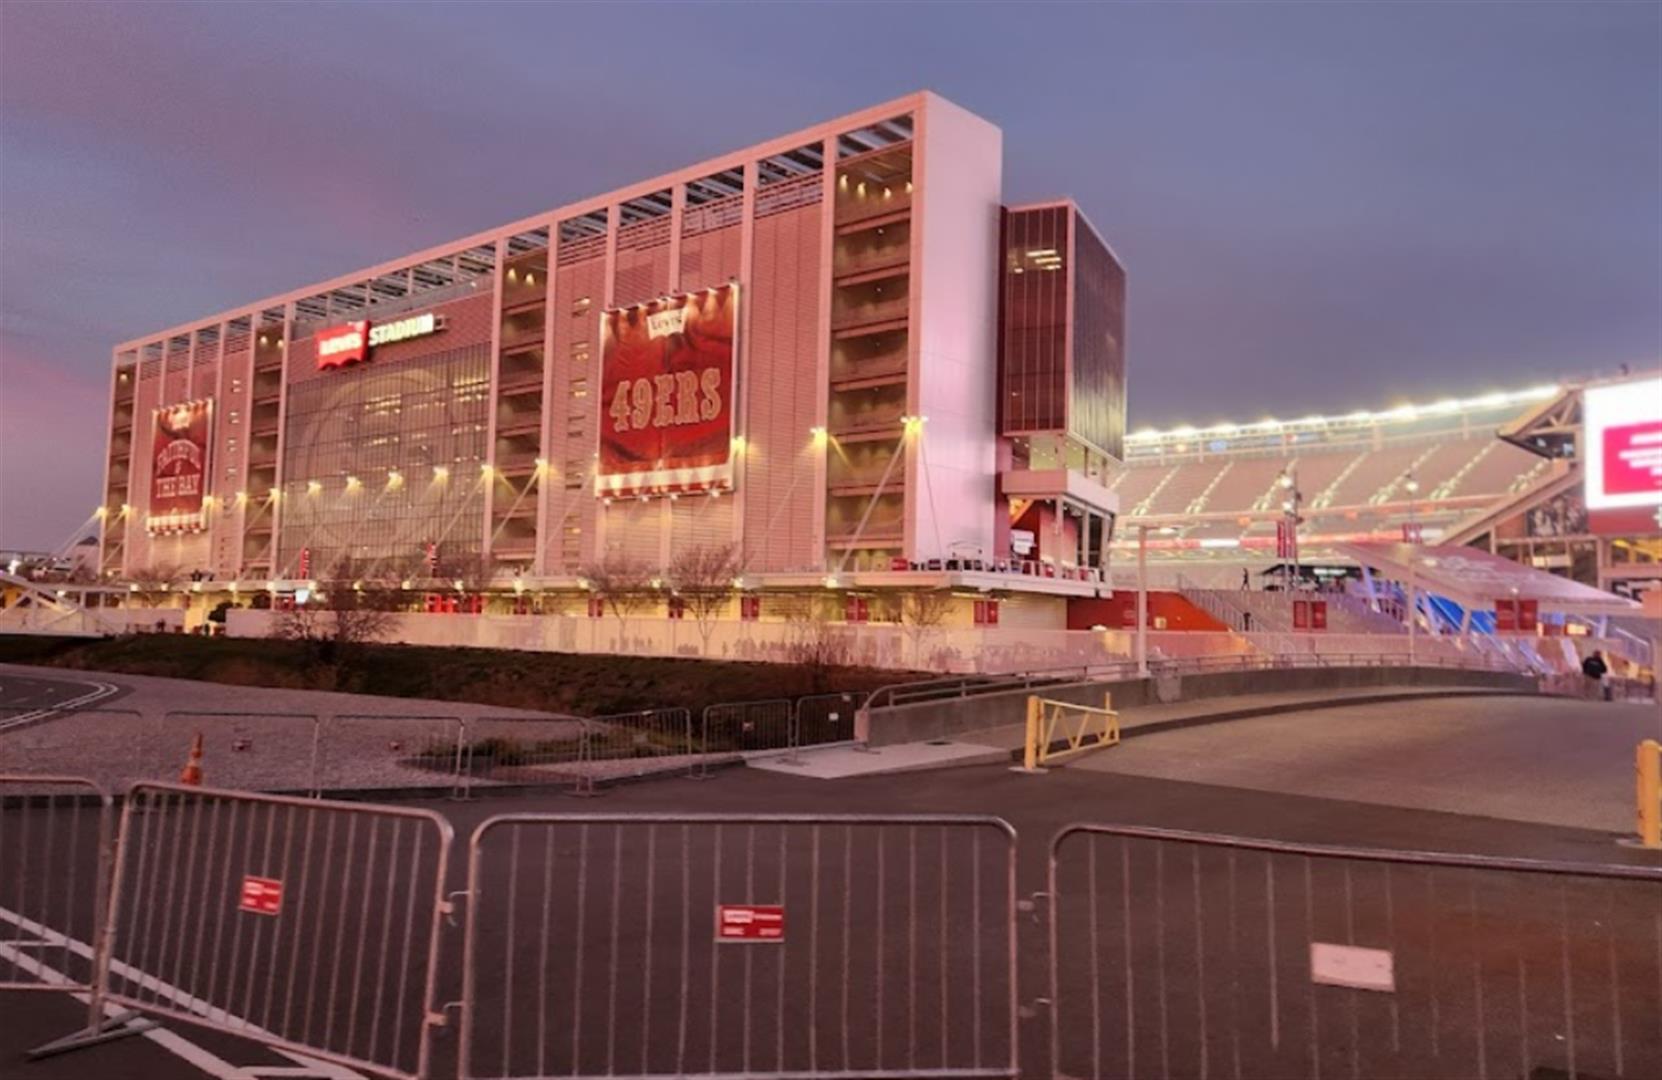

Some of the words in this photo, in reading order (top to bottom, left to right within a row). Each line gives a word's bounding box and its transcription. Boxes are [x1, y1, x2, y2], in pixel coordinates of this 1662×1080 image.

[368, 313, 434, 347] STADIUM
[609, 367, 722, 432] 49ERS
[156, 477, 176, 498] THE
[178, 474, 200, 496] BAY
